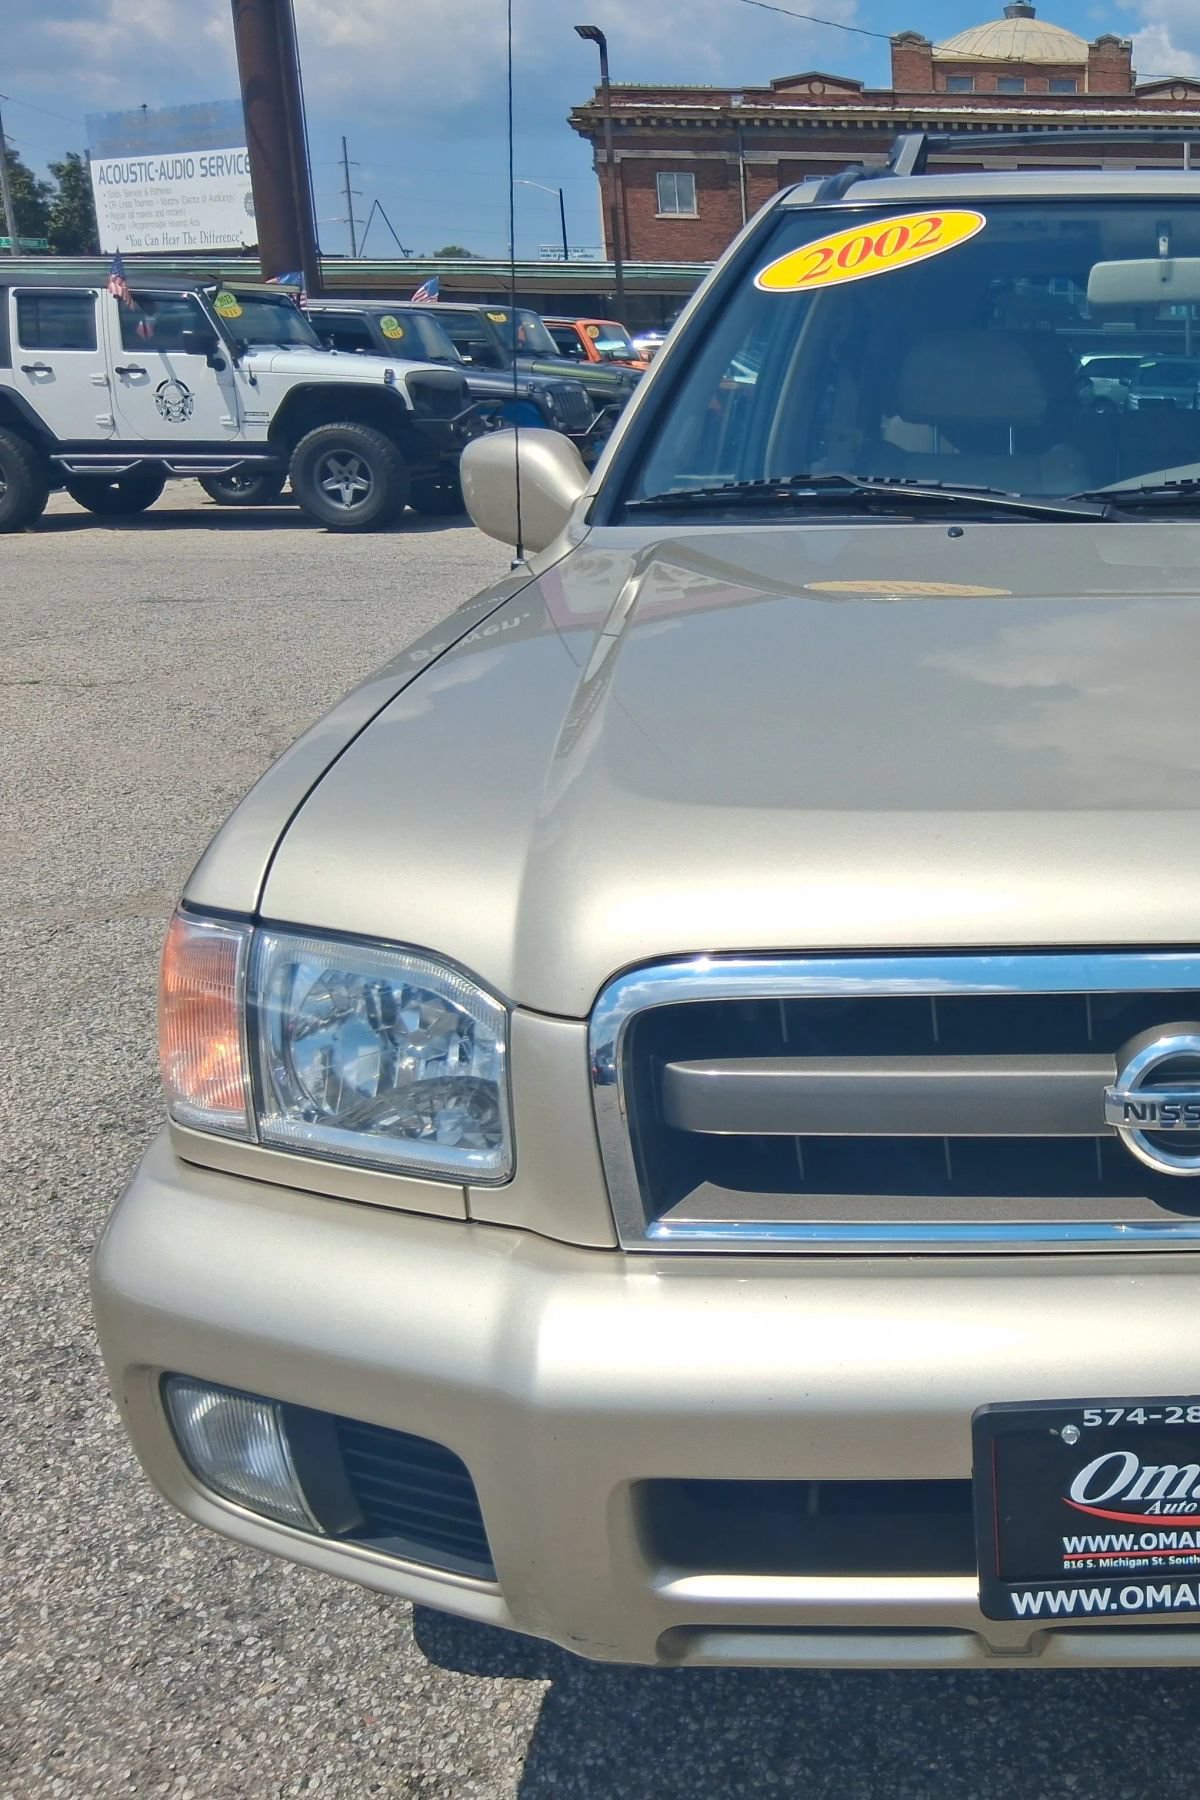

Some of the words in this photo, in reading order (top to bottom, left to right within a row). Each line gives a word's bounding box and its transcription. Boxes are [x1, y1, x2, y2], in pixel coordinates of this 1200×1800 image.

[99, 158, 195, 185] ACOUSTIC-AUDIO
[144, 233, 160, 246] Can
[162, 232, 180, 245] Hear
[182, 231, 197, 245] The
[797, 217, 943, 284] 2002
[1144, 1500, 1198, 1515] Auto
[1063, 1560, 1084, 1569] 816
[1099, 1558, 1149, 1568] Michigan
[1151, 1557, 1166, 1566] St.
[1168, 1555, 1200, 1565] South
